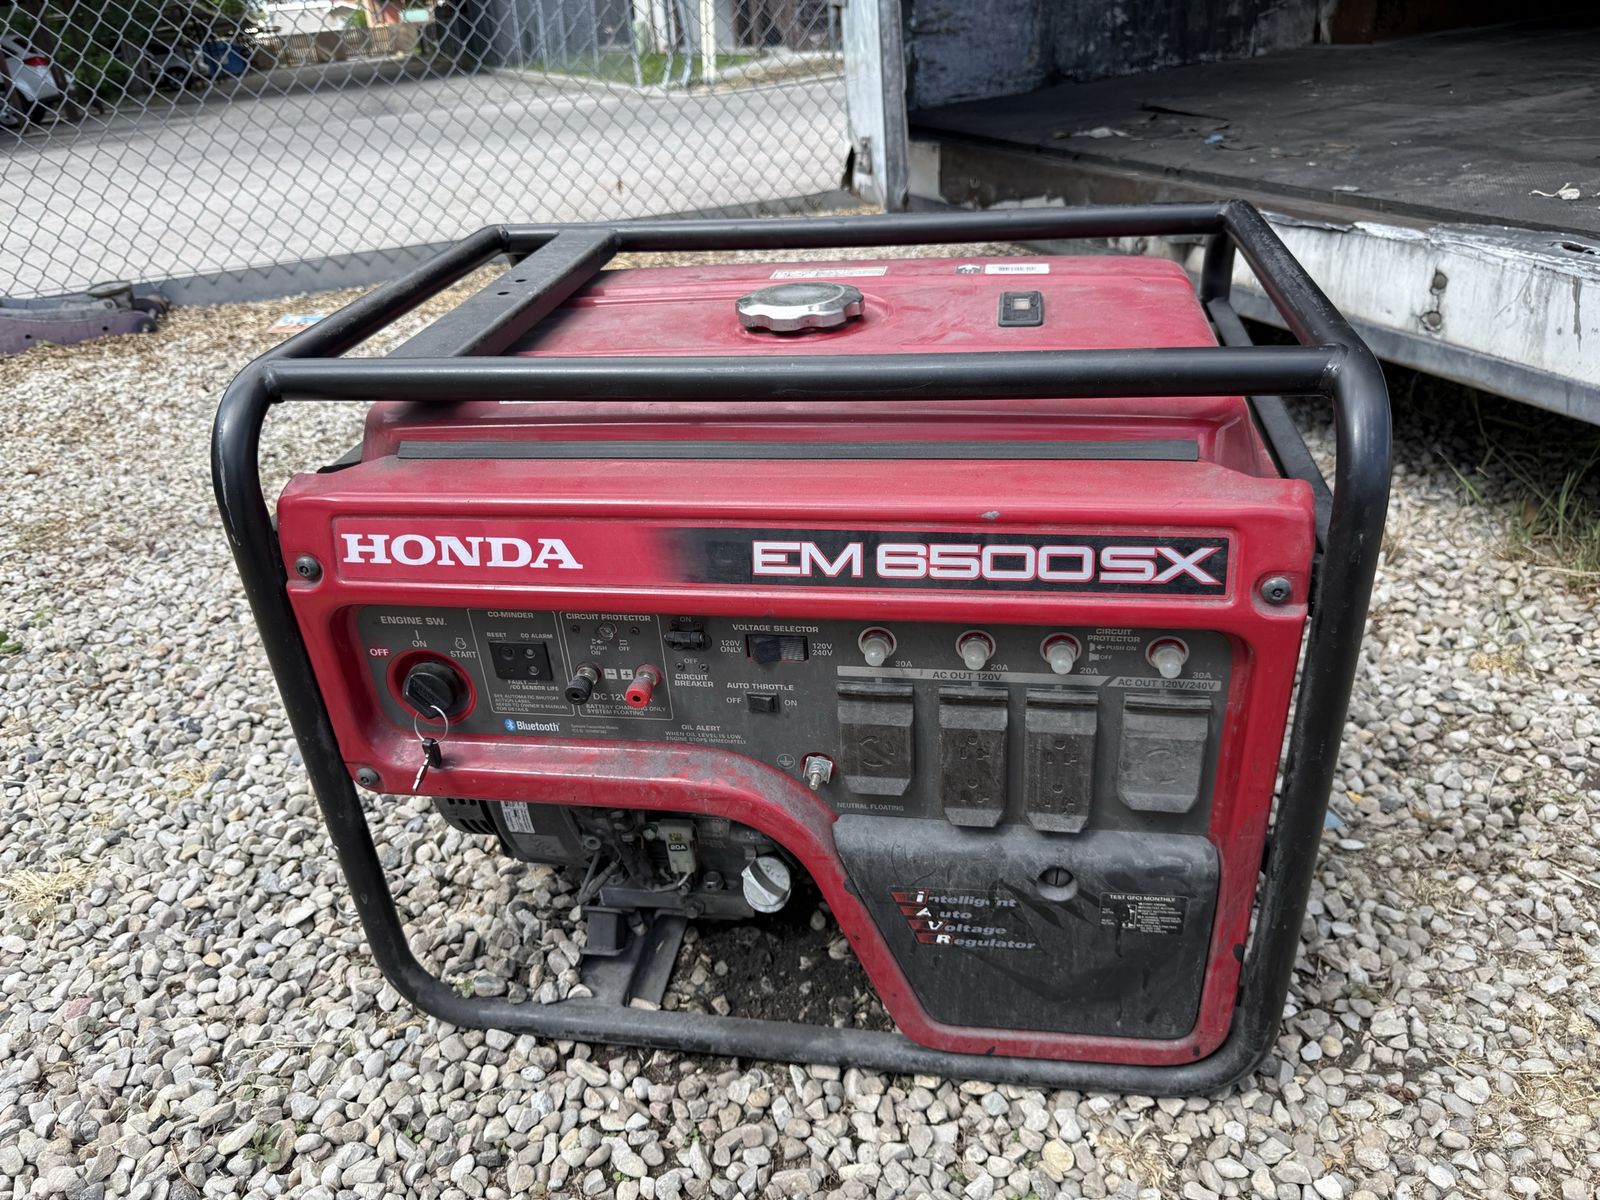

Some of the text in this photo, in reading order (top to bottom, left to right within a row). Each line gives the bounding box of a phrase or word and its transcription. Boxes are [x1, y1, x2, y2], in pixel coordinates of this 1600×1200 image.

[341, 533, 583, 569] HONDA
[752, 540, 863, 578] EM
[487, 611, 534, 619] CO-MINDER
[566, 612, 651, 621] CIRCUIT PROTECTOR
[380, 616, 447, 626] ENGINE SW.
[732, 624, 819, 633] VOLTAGE SELECTOR
[1087, 634, 1141, 642] PROTECTOR
[412, 640, 427, 648] ON
[721, 639, 740, 647] 120V
[812, 642, 833, 650] 120V
[369, 648, 389, 657] OFF
[449, 650, 477, 659] START
[895, 660, 913, 668] 30A
[990, 663, 1009, 671] 20A
[1080, 667, 1099, 675] 20A
[675, 673, 709, 681] CIRCUIT
[932, 672, 1002, 681] AC OUT 120V
[1192, 672, 1212, 680] 30A
[674, 680, 714, 688] BREAKER
[752, 683, 794, 691] THROTTLE
[1117, 678, 1216, 690] AC OUT 120V/240V
[593, 692, 607, 701] DC
[784, 699, 798, 707] ON
[516, 720, 559, 732] Bluetooth
[836, 802, 905, 811] NEUTRAL FLOATING
[928, 920, 1007, 936] Voltage
[936, 934, 1036, 949] Regulator
